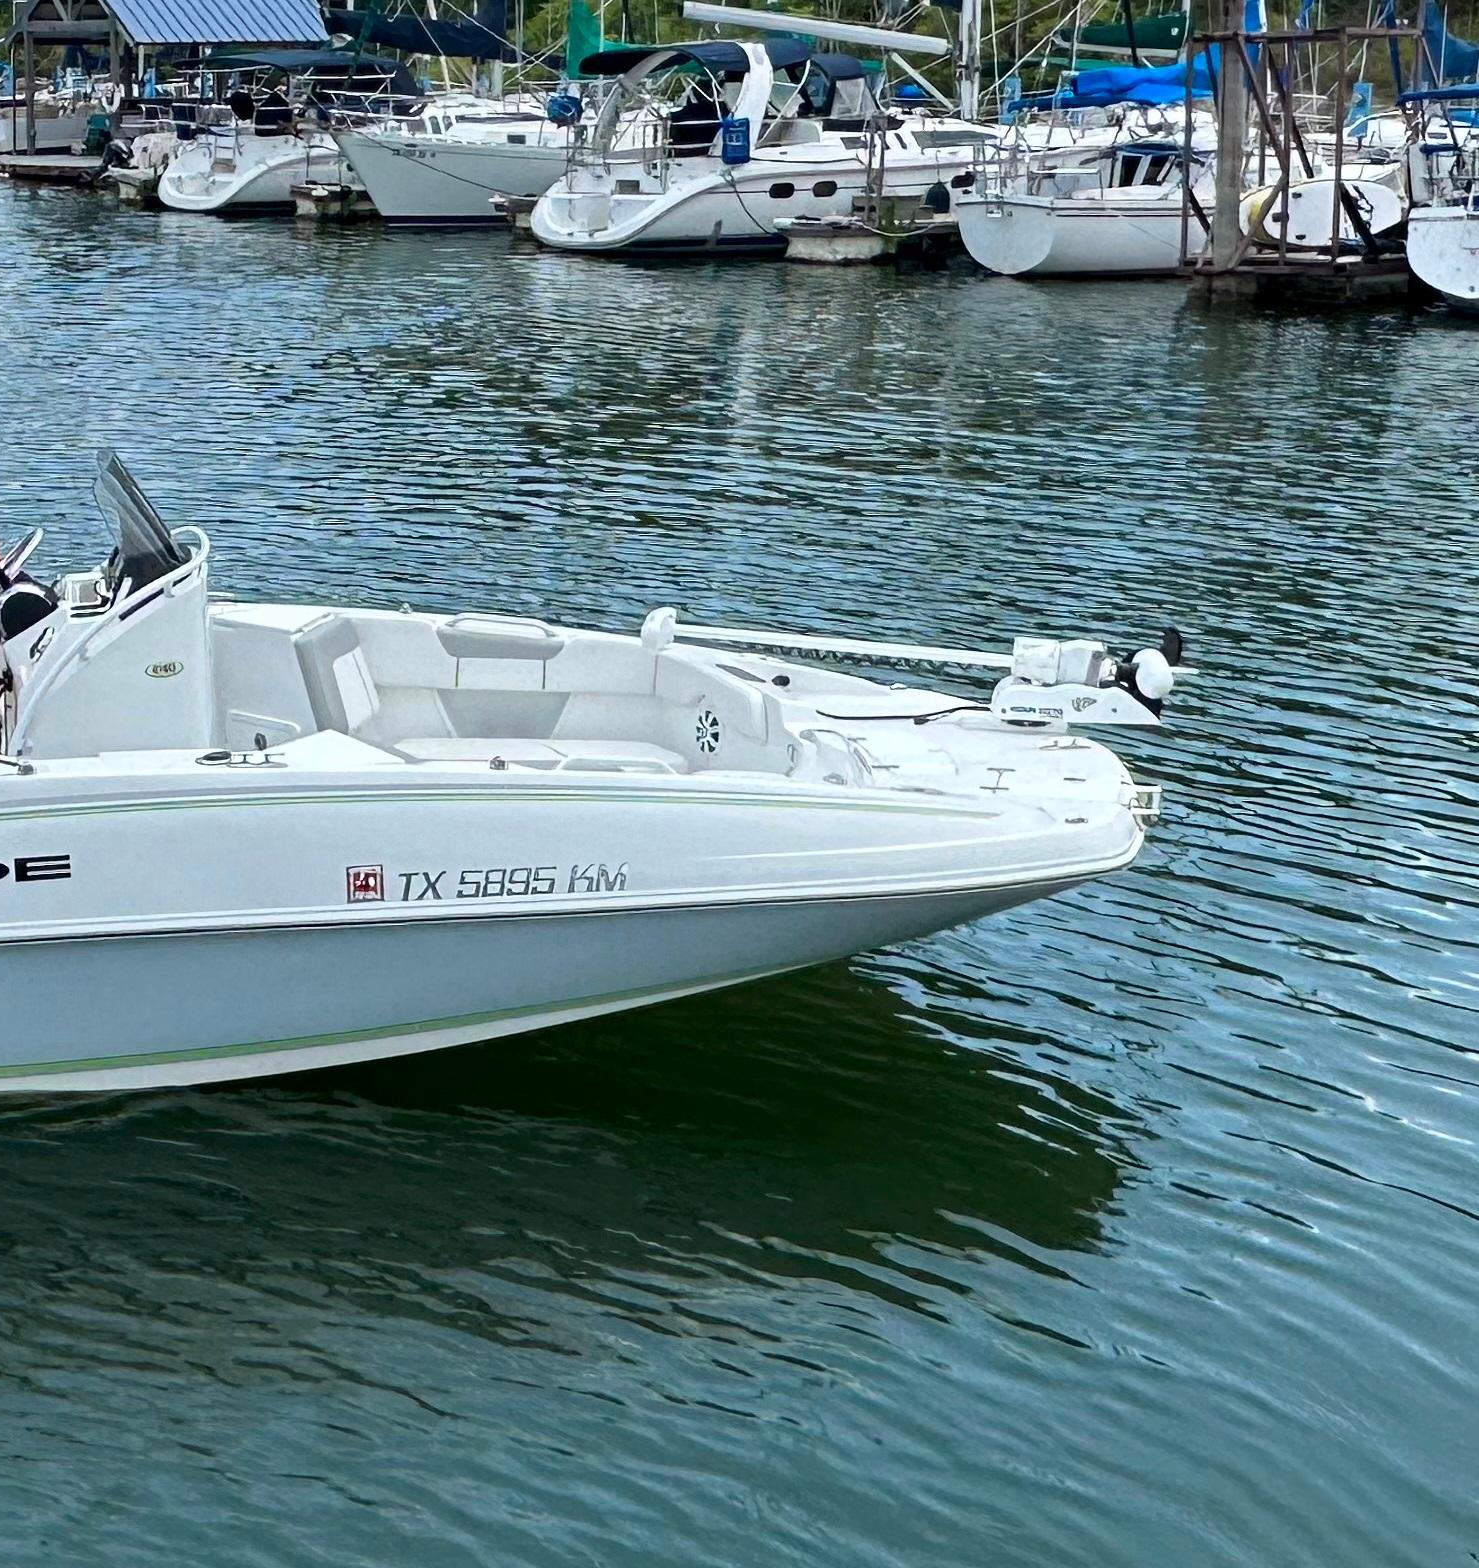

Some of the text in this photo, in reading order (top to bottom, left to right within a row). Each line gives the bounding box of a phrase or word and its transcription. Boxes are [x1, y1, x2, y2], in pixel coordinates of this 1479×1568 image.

[398, 870, 447, 901] TX
[456, 866, 557, 898] 5895
[567, 861, 628, 894] KM
